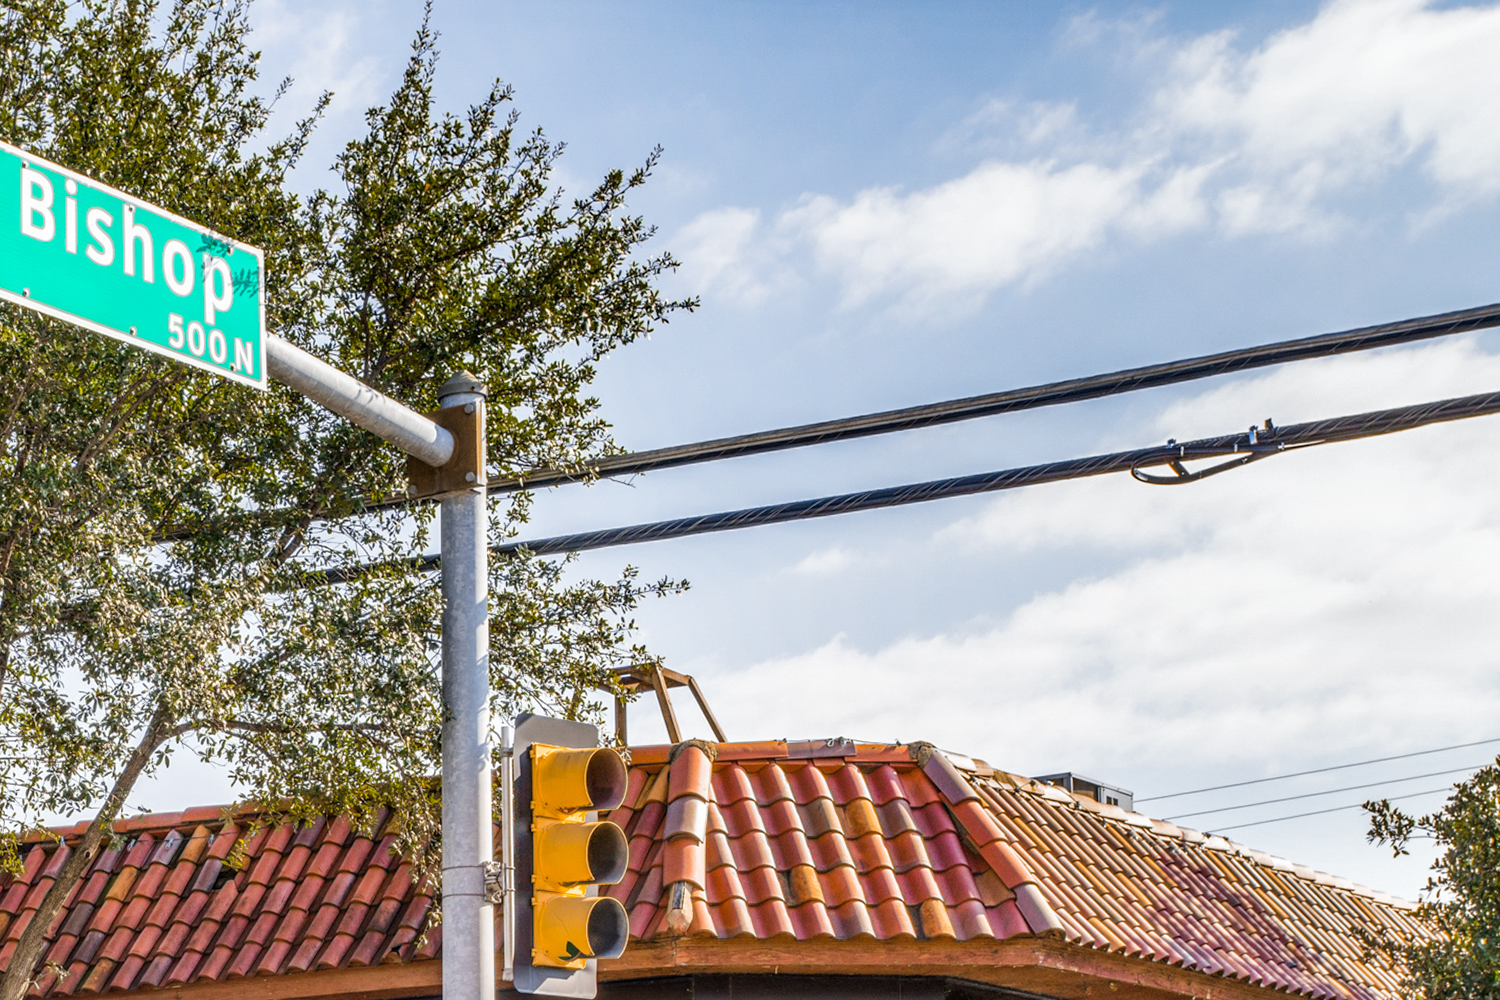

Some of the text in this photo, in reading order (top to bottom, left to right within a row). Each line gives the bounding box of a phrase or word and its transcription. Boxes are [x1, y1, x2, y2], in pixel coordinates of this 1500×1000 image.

[20, 167, 234, 326] Bishop
[168, 312, 253, 375] 500 N
